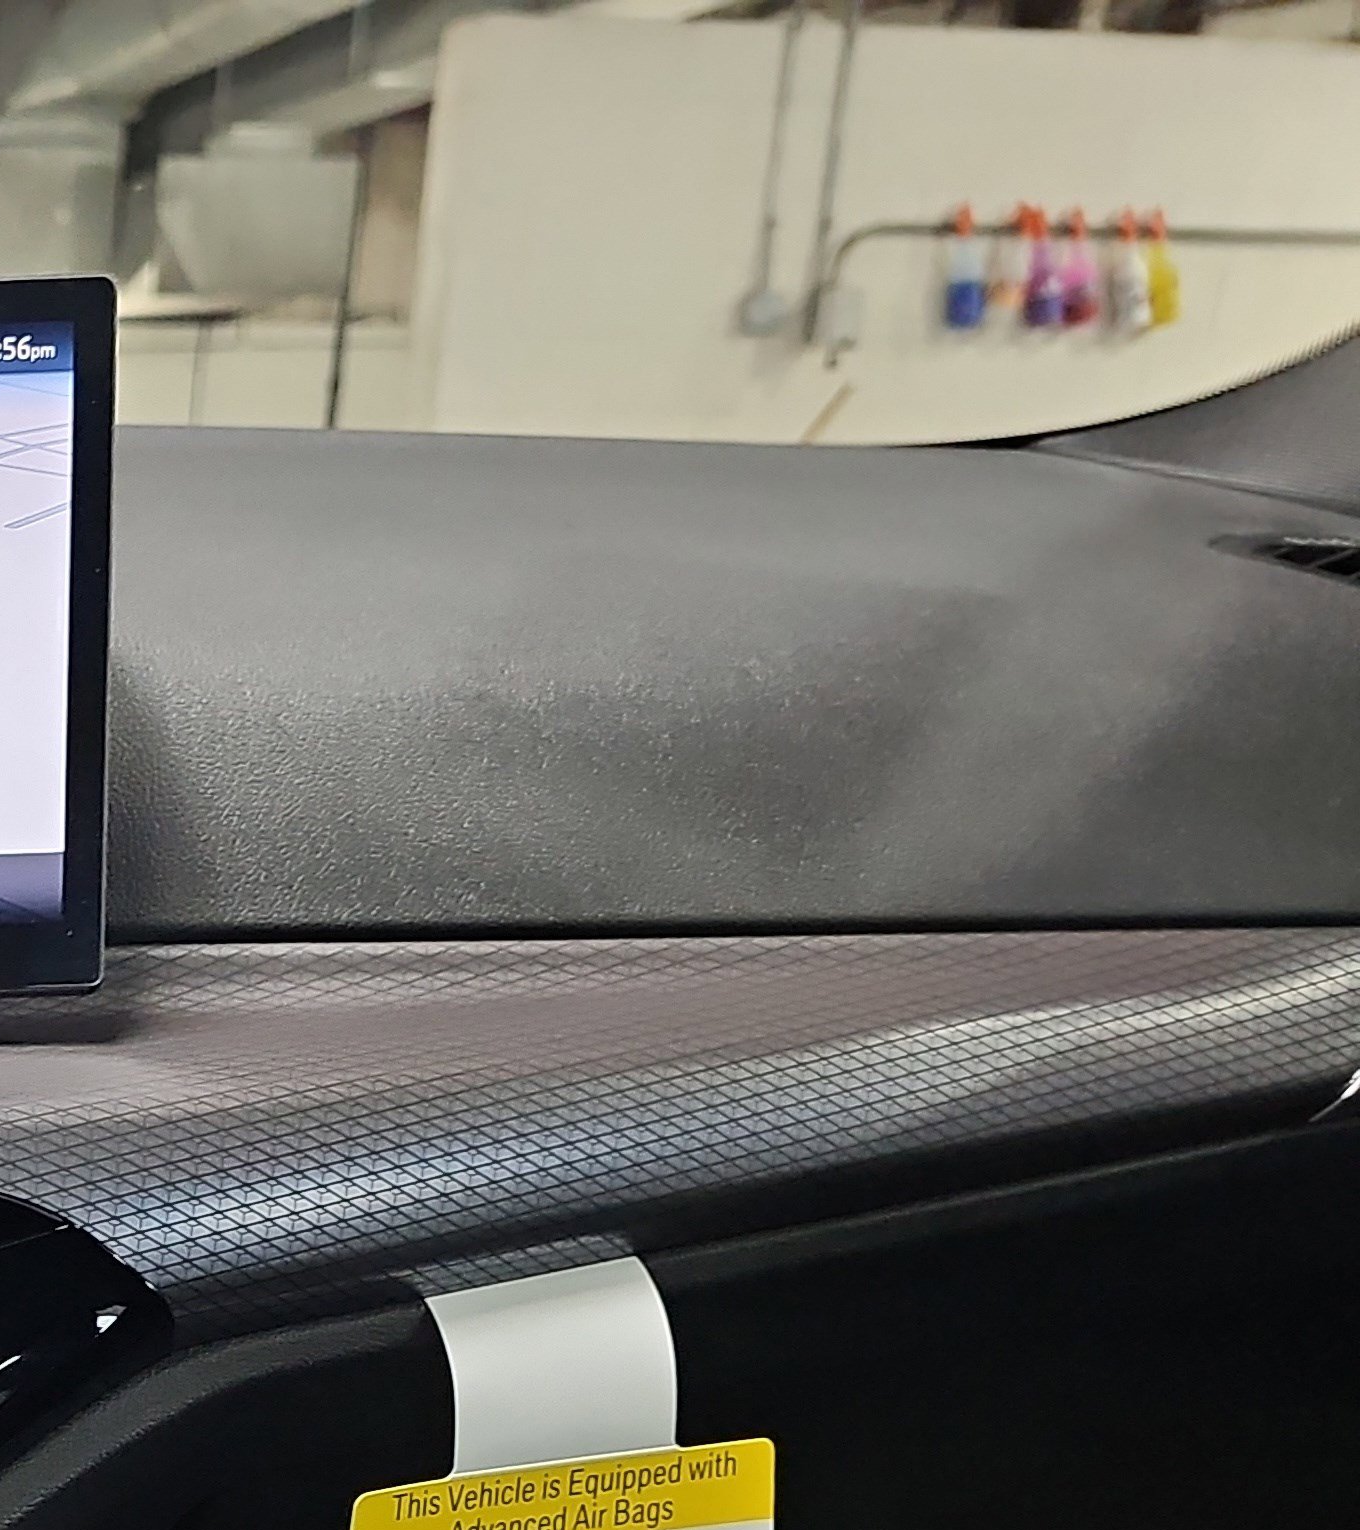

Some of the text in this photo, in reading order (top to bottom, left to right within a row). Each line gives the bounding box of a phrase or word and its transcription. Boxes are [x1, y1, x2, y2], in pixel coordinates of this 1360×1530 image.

[392, 1450, 737, 1521] This Vehicle is Equipped with
[572, 1502, 608, 1530] Air
[613, 1499, 673, 1529] Bags
